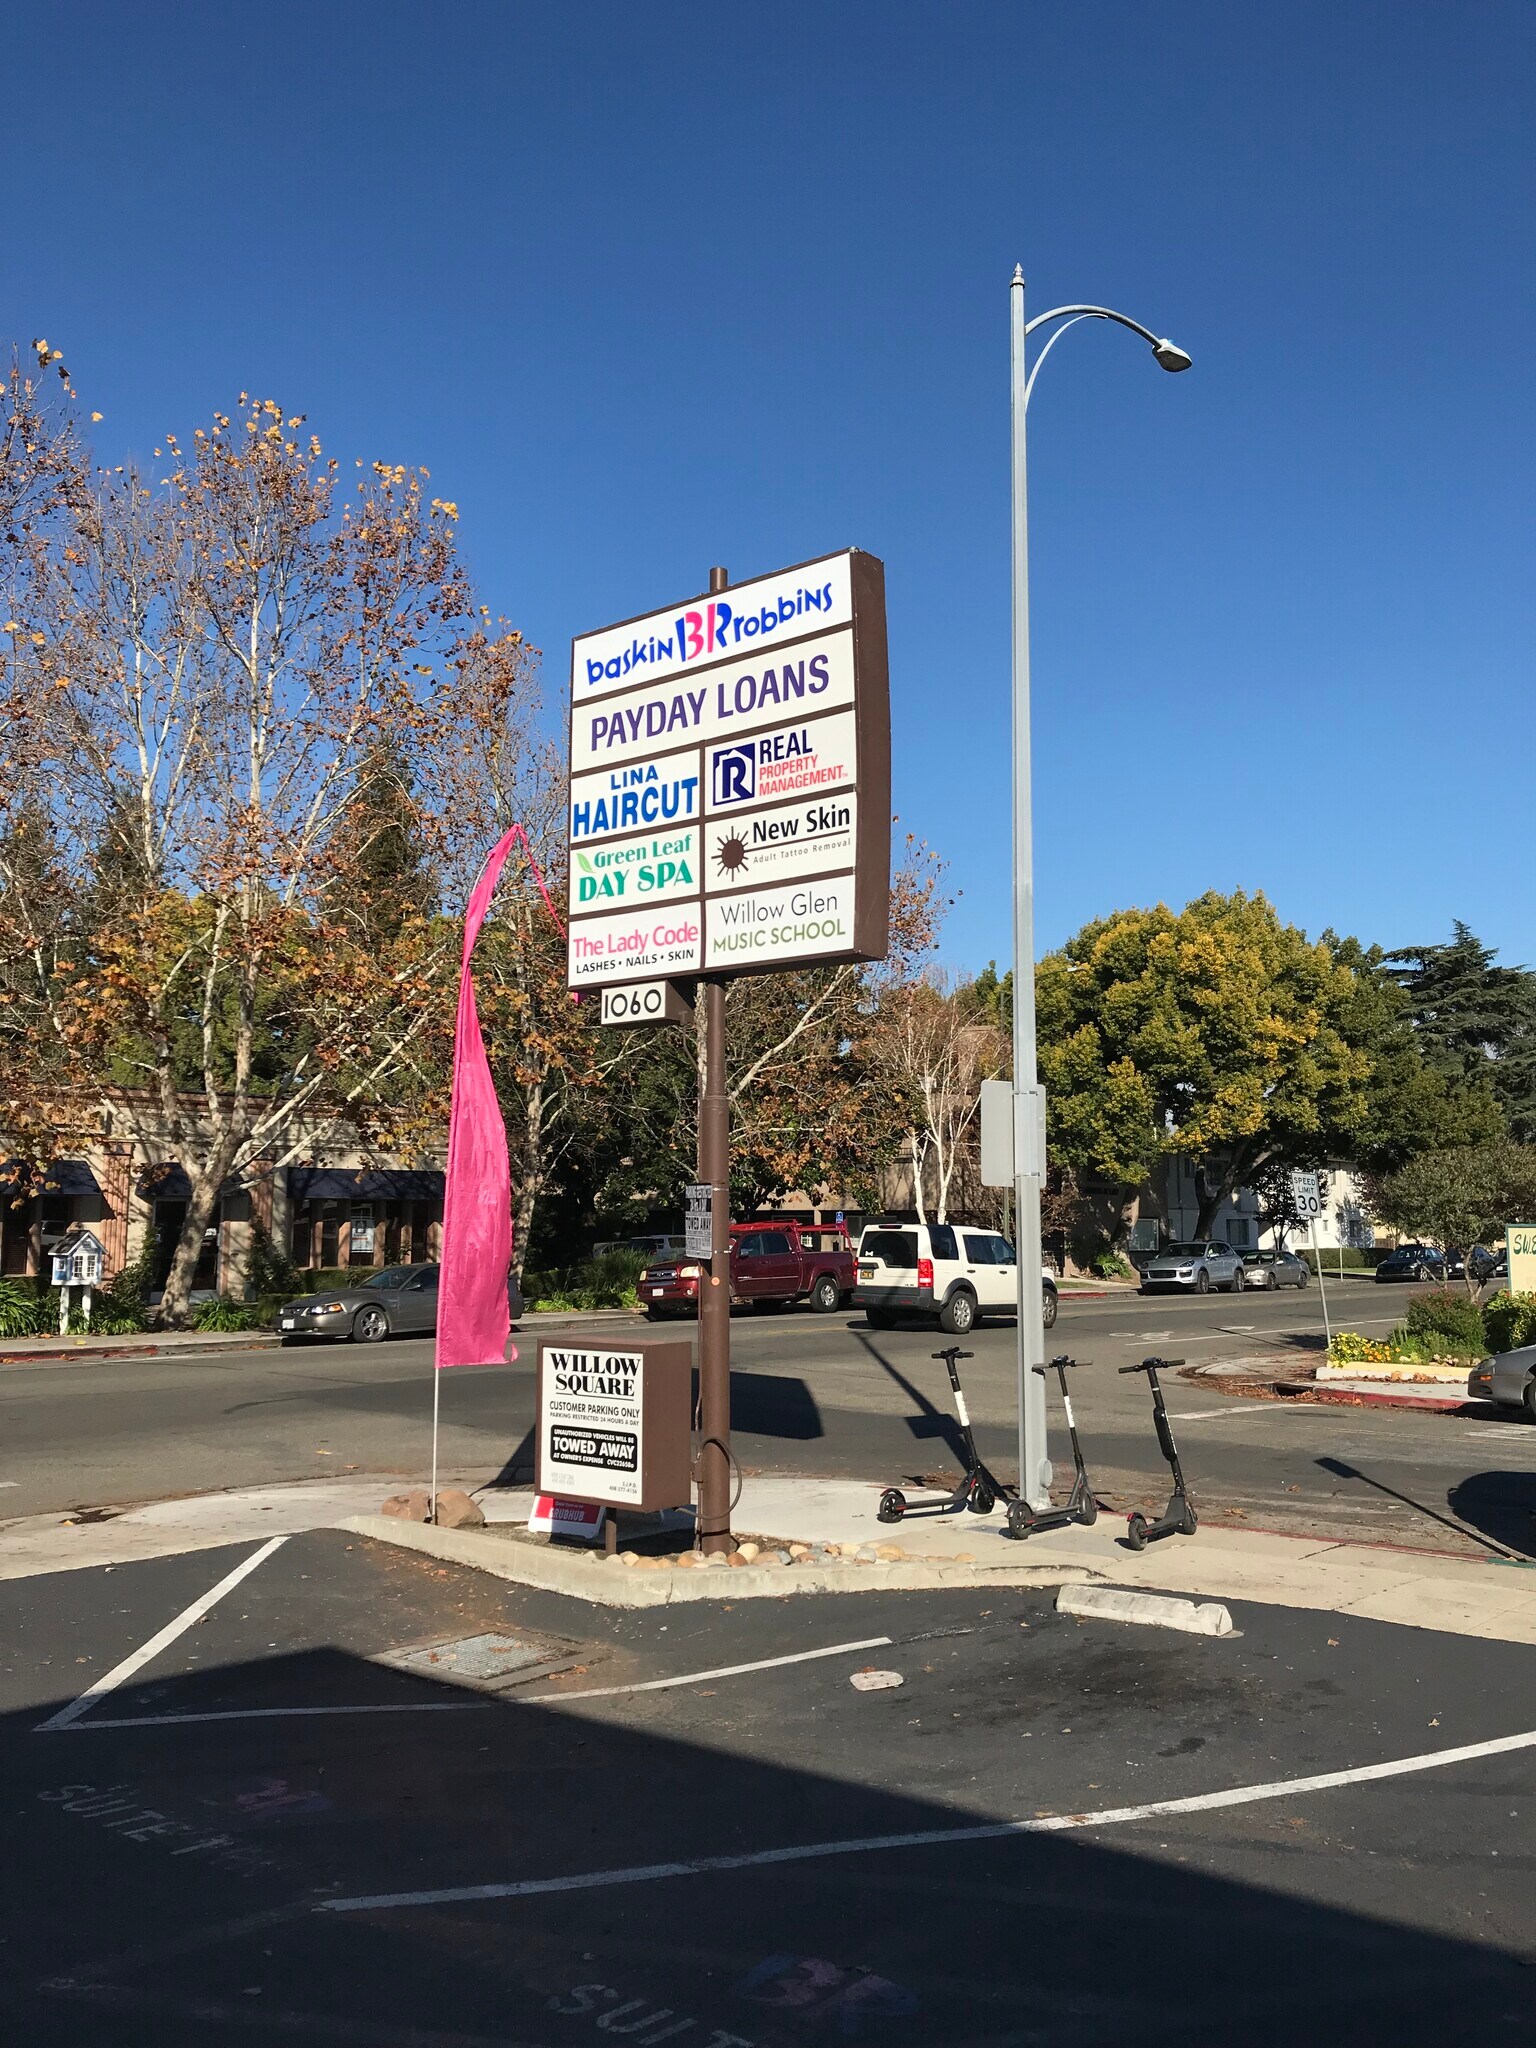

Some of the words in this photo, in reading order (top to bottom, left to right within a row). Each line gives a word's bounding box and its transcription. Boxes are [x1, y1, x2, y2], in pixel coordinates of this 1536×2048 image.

[586, 636, 673, 686] baskin
[734, 582, 832, 642] robbins
[591, 688, 707, 751] PAYDAY
[718, 654, 829, 719] LOANS
[759, 729, 813, 764] REAL
[611, 765, 659, 790] LINA
[759, 754, 818, 780] PROPERTY
[759, 765, 844, 797] MANAGEMENT
[573, 776, 698, 837] HAIRCUT
[753, 818, 799, 843] New
[806, 804, 850, 833] Skin
[594, 846, 647, 868] Green
[652, 834, 692, 858] Leaf
[753, 853, 777, 864] Adult
[780, 847, 808, 859] Tattoo
[813, 838, 851, 852] Removal
[579, 869, 630, 902] DAY
[637, 859, 693, 892] SPA
[720, 900, 785, 925] Willow
[791, 891, 837, 916] Glen
[573, 937, 604, 958] The
[608, 929, 649, 955] Lady
[652, 921, 699, 947] Code
[713, 930, 766, 953] MUSIC
[771, 919, 846, 944] SCHOOL
[576, 960, 616, 974] LASHES
[626, 954, 657, 967] NAILS
[668, 949, 694, 961] SKIN
[604, 988, 662, 1019] 1060
[1293, 1176, 1316, 1186] SPEED
[1298, 1186, 1314, 1194] LIMIT
[1297, 1194, 1318, 1212] 30
[550, 1353, 641, 1377] WILLOW
[555, 1373, 635, 1397] SQUARE
[549, 1400, 586, 1413] CUSTOMER
[587, 1404, 620, 1416] PARKING
[621, 1407, 640, 1418] ONLY
[550, 1411, 571, 1419] PARKING
[572, 1413, 599, 1422] RESTRICTED
[553, 1428, 593, 1439] UNAUTHORIZED
[593, 1432, 615, 1441] VEHICLES
[615, 1435, 627, 1443] WILL
[627, 1436, 634, 1444] BE
[553, 1436, 597, 1455] TOWED
[599, 1442, 635, 1459] AWAY
[582, 1455, 604, 1465] EXPENSE
